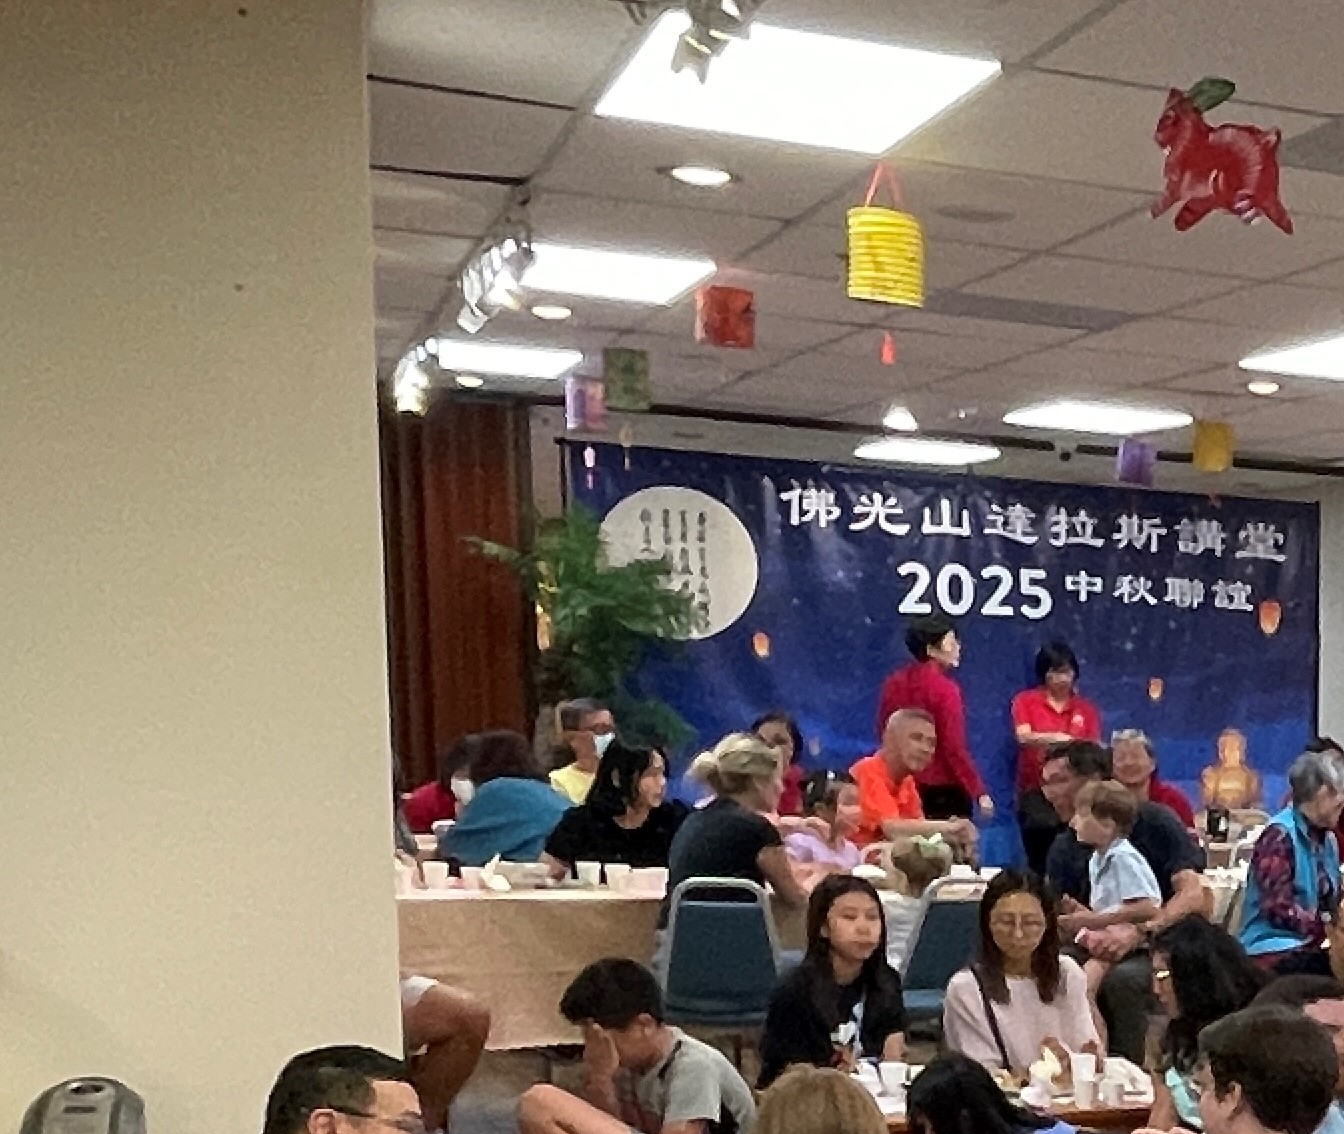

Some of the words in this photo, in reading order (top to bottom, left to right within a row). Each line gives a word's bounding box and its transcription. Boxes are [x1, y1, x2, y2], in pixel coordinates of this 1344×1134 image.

[778, 487, 1288, 562] 佛光山達拉斯講堂
